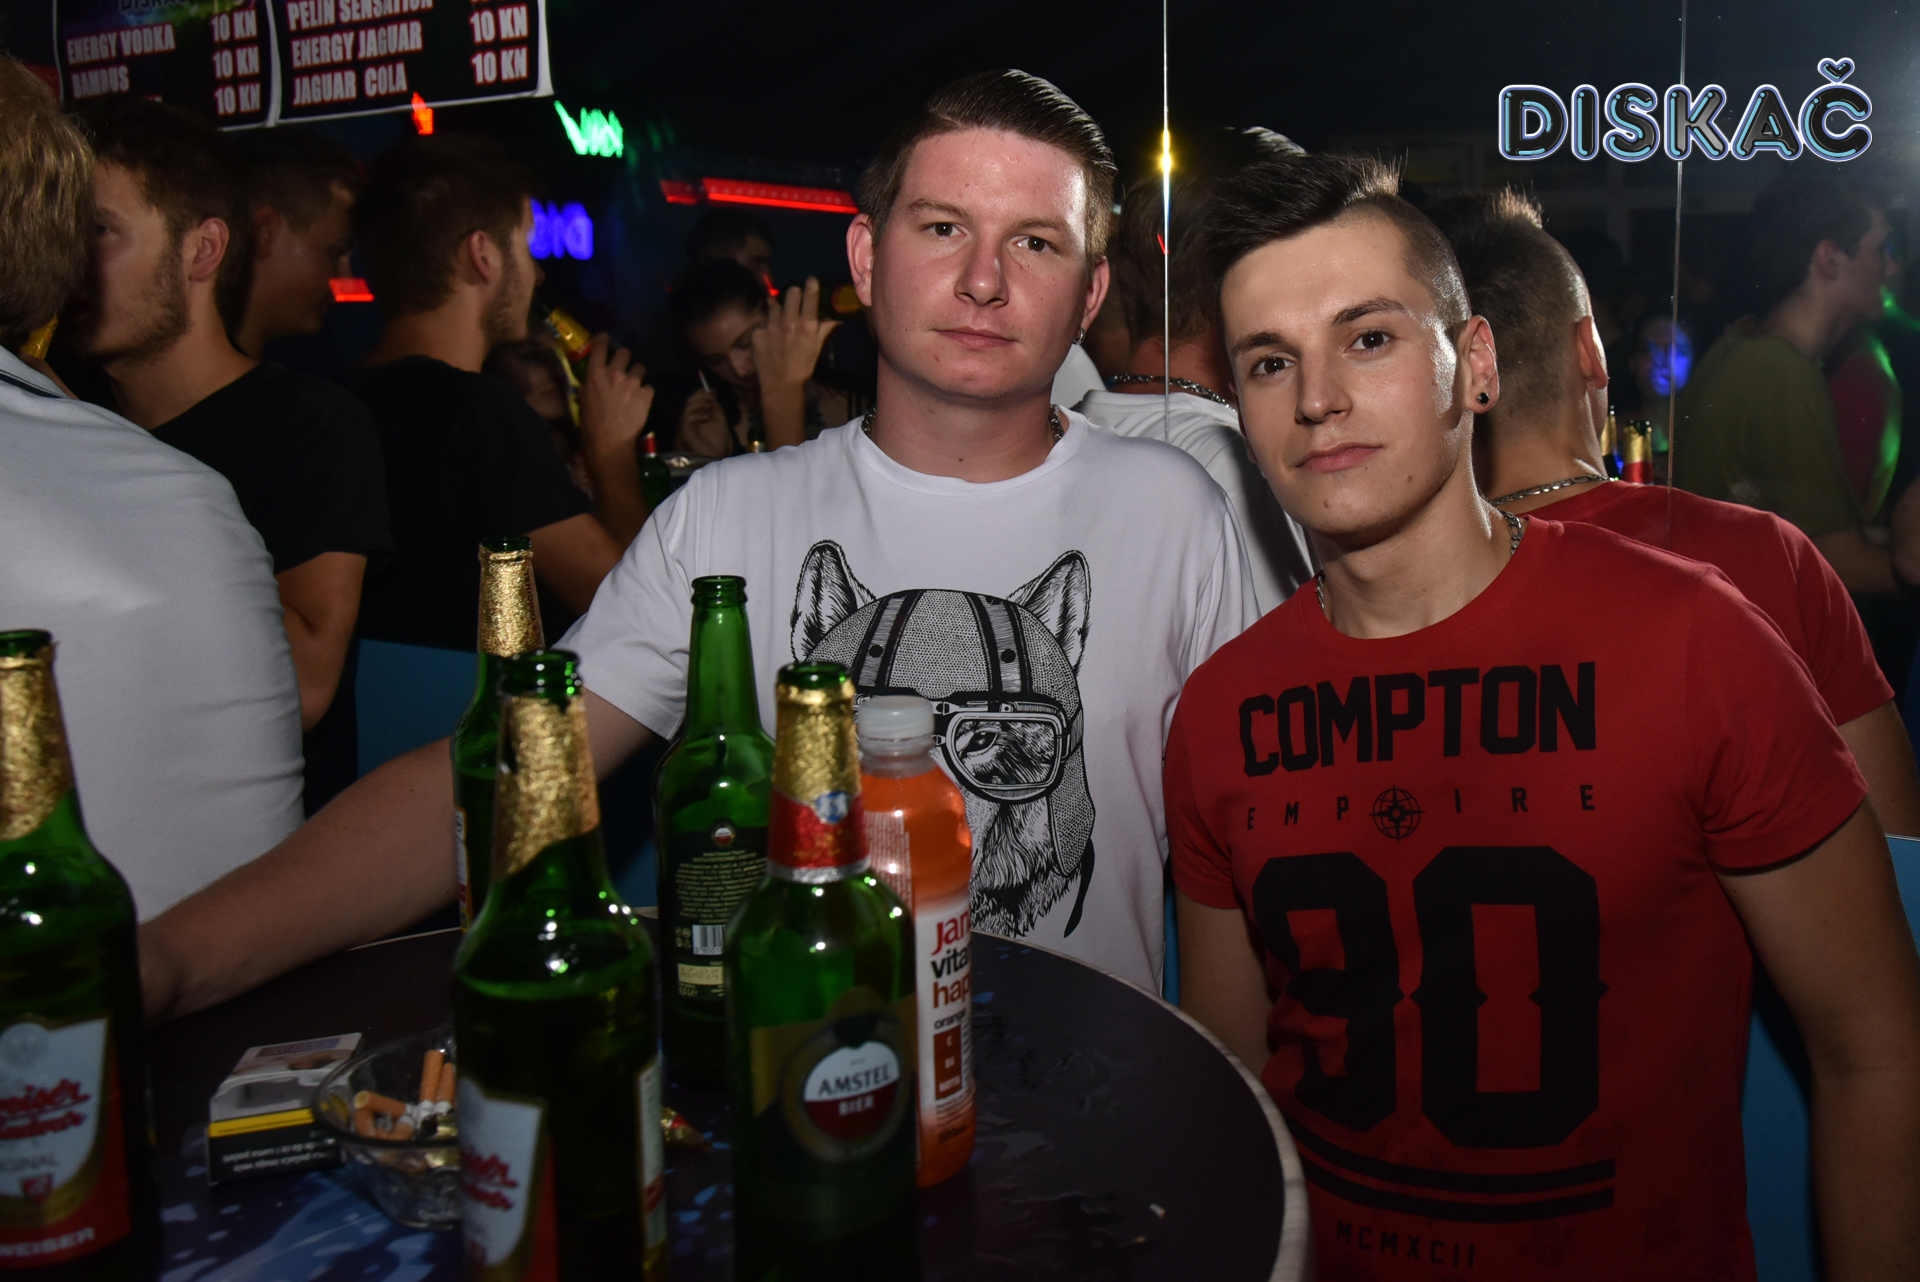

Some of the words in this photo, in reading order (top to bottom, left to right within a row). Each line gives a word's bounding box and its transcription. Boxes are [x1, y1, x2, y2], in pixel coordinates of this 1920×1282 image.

[66, 32, 118, 66] ENERGY
[119, 22, 176, 57] VODKA
[211, 13, 232, 43] 10
[232, 7, 258, 40] KN
[286, 0, 336, 31] PELIN
[291, 31, 356, 70] ENERGY
[356, 20, 424, 61] JAGUAR
[469, 10, 496, 45] 10
[497, 4, 529, 41] KN
[213, 48, 234, 80] 10
[235, 44, 260, 77] KN
[292, 69, 358, 107] JAGUAR
[364, 60, 408, 98] COLA
[471, 50, 498, 86] 10
[499, 46, 529, 82] KN
[215, 85, 237, 117] 10
[238, 81, 261, 114] KN
[1238, 661, 1596, 777] COMPTON
[1250, 845, 1610, 1149] 90
[817, 1063, 890, 1096] AMSTEL
[838, 1094, 875, 1117] BIER
[1335, 1218, 1475, 1268] MCMXCII
